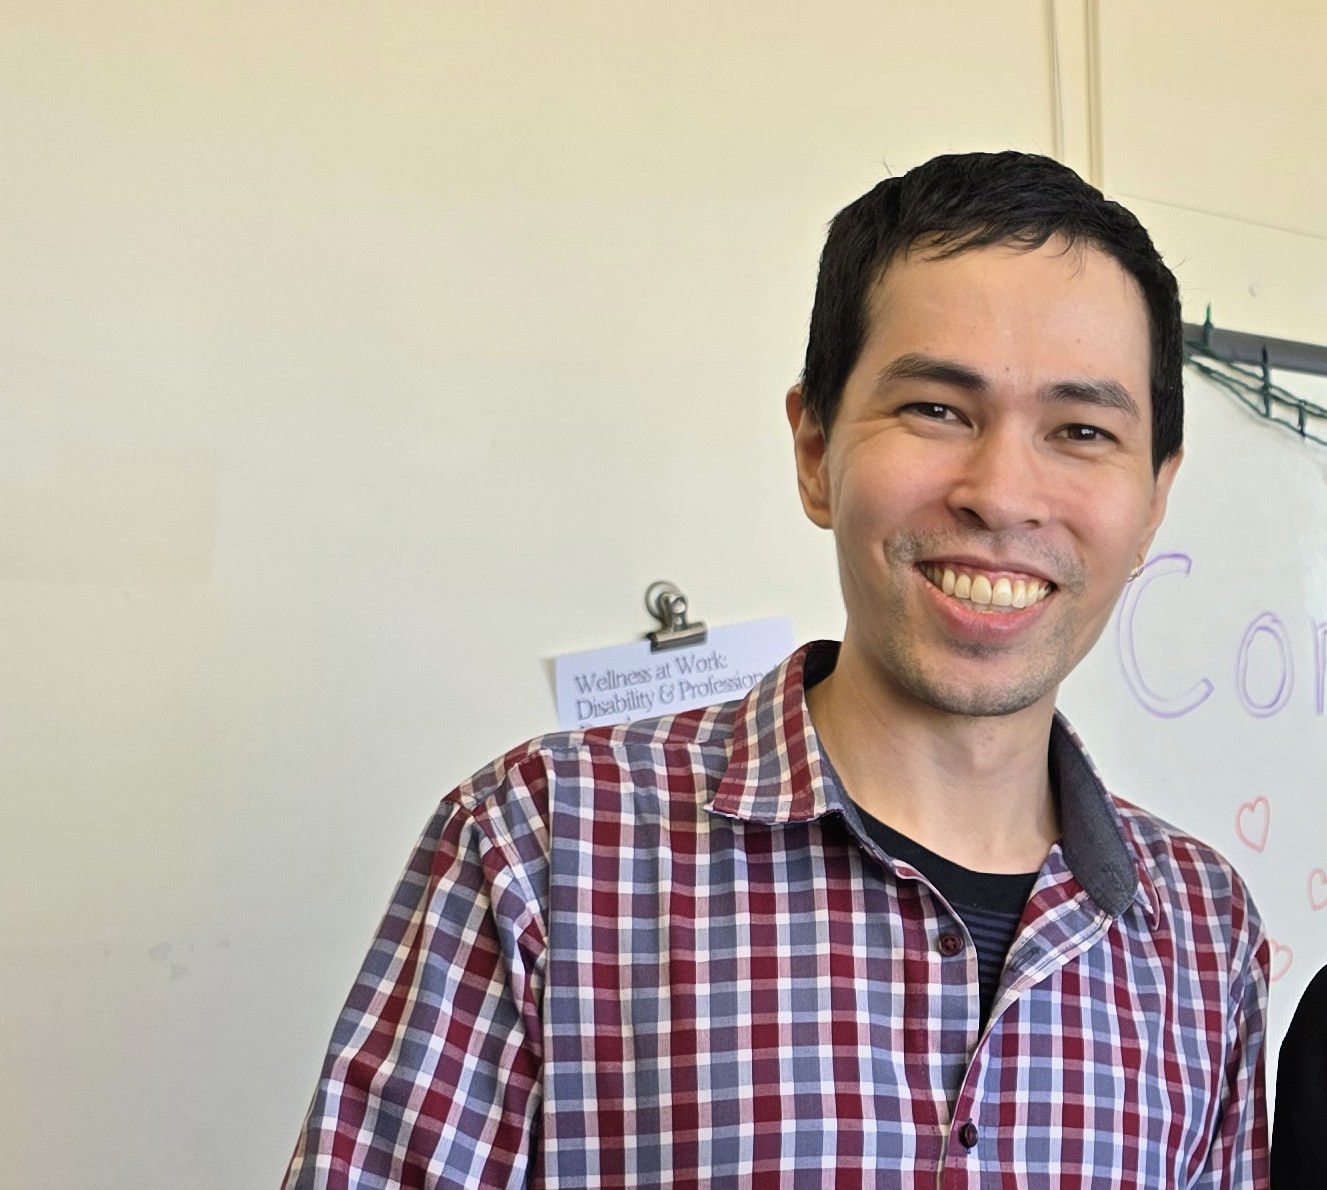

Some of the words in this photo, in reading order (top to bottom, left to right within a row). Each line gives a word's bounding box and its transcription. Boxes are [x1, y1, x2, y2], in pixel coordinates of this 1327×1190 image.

[574, 667, 653, 695] Wellness
[655, 663, 672, 680] at
[676, 649, 728, 674] Work:
[576, 689, 655, 722] Disability
[659, 685, 675, 705] &
[679, 669, 765, 707] Profession
